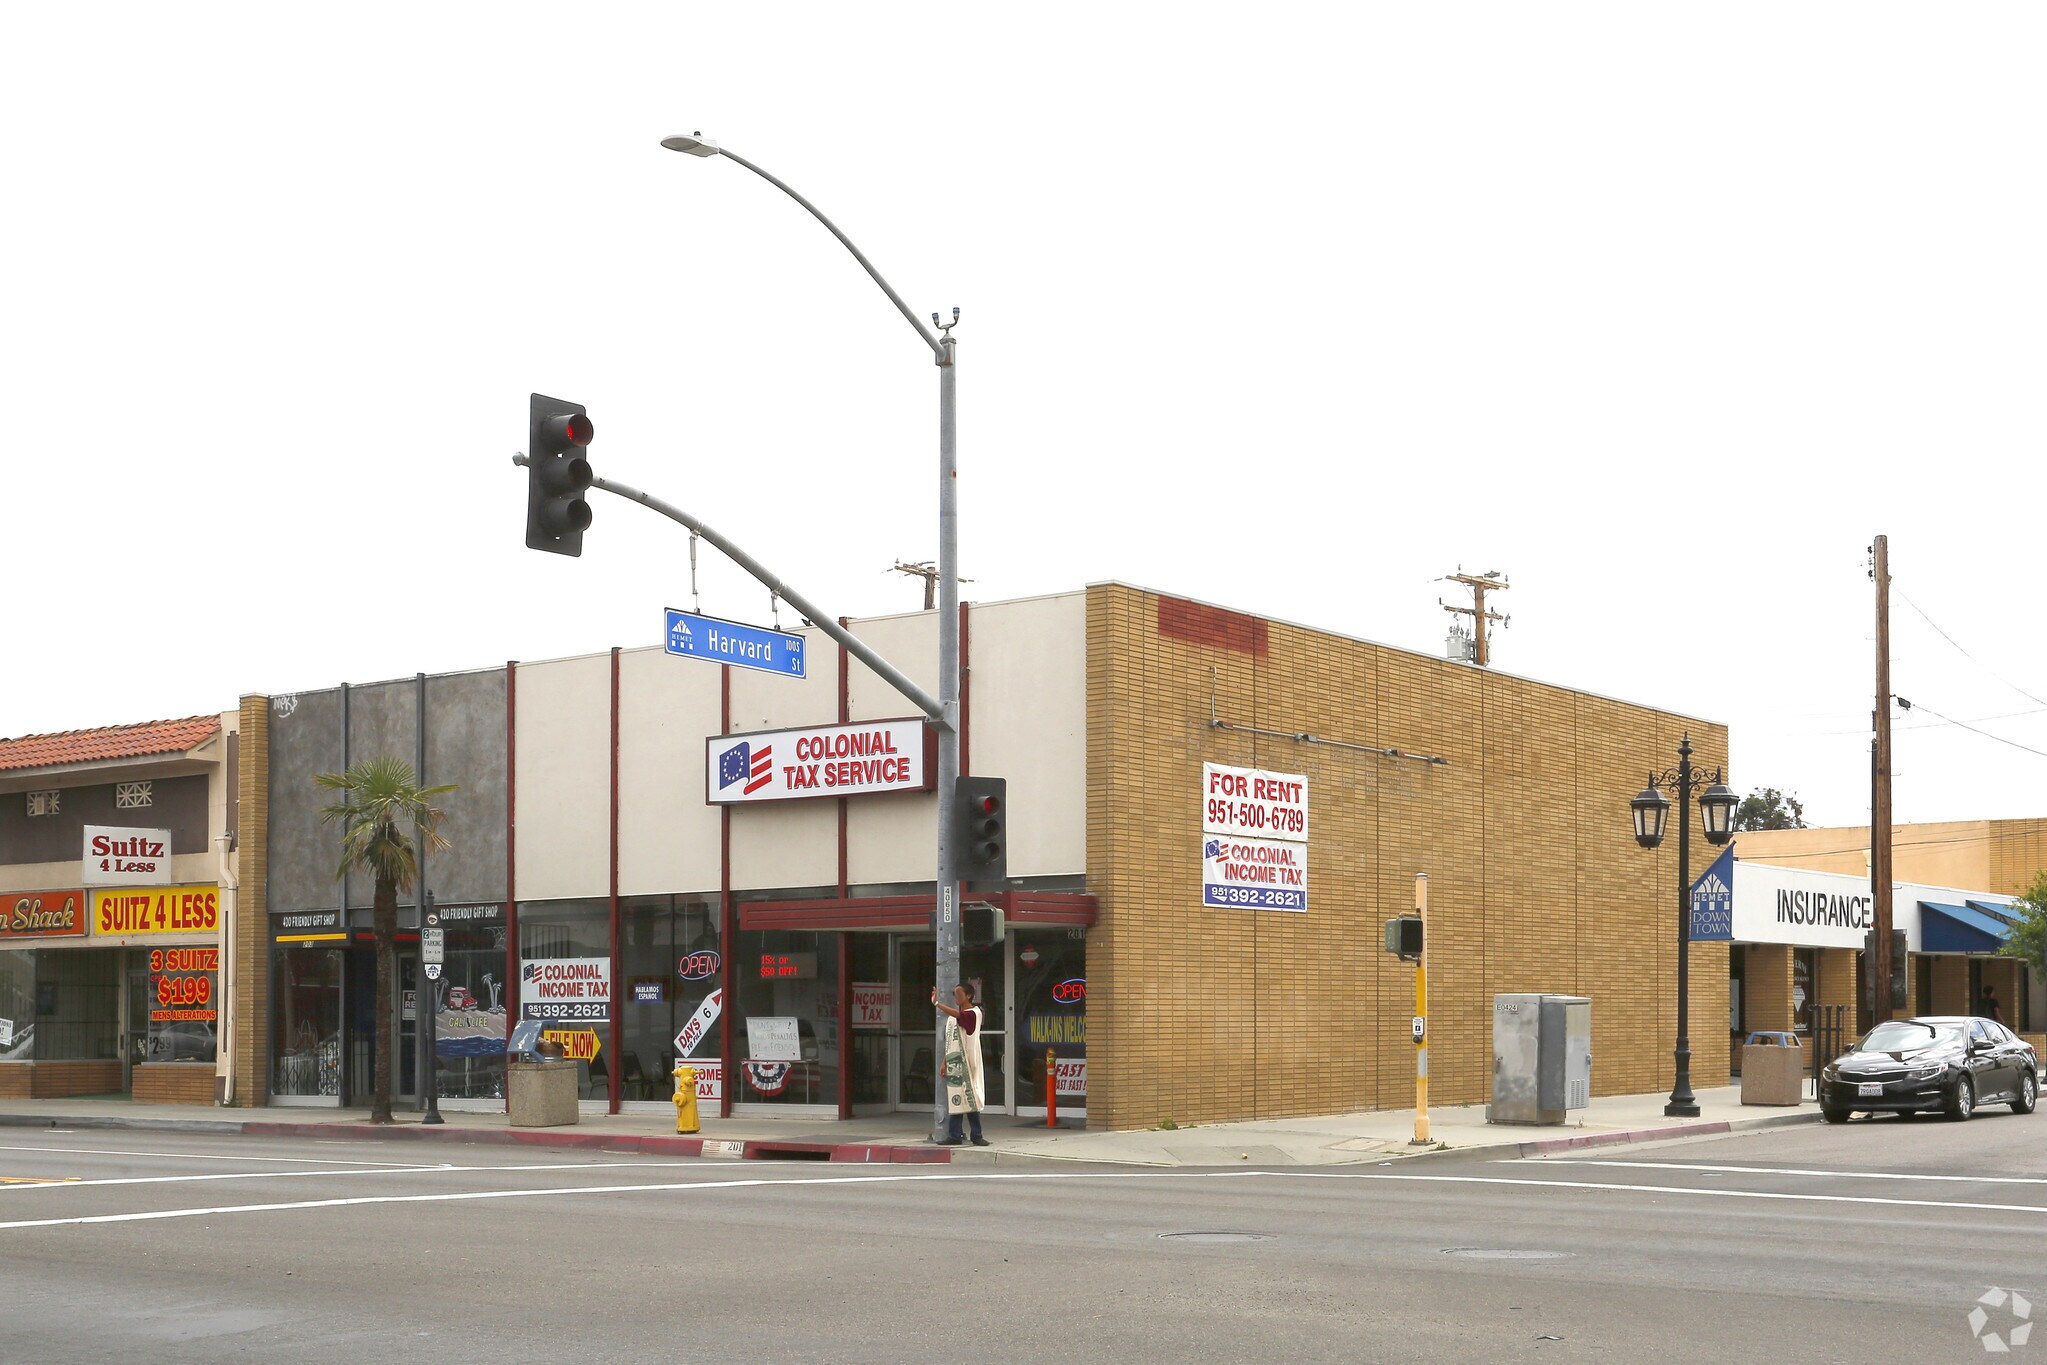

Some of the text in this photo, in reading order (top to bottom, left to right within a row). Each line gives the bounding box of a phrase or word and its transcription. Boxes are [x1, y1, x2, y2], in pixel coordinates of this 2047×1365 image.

[708, 628, 772, 661] Harvard
[791, 657, 801, 671] St
[796, 730, 898, 761] COLONIAL
[783, 757, 910, 790] TAX SERVICE
[1210, 772, 1302, 803] FOR RENT
[1208, 798, 1304, 832] 951-500-6789
[92, 835, 164, 858] Suitz
[1231, 844, 1296, 866] COLONIAL
[100, 859, 156, 872] 4 Less
[1225, 863, 1302, 885] INCOME TAX
[1211, 887, 1300, 905] 951 392-2621
[1694, 893, 1729, 901] HEMET
[12, 897, 74, 930] Shack
[101, 893, 216, 931] SUITZ 4 LESS
[450, 907, 472, 919] FRIENDLY
[473, 906, 484, 918] GIFT
[485, 905, 498, 917] SHOP
[1693, 911, 1729, 922] DOWN
[1777, 888, 1870, 929] INSURANCE
[292, 915, 312, 927] FRIENDLY
[313, 915, 323, 926] GIFT
[323, 914, 335, 925] SHOP
[1693, 923, 1729, 934] TOWN
[423, 930, 429, 939] 2
[150, 948, 219, 972] 3 SUITZ
[679, 955, 717, 975] OPEN
[544, 964, 602, 980] COLONIAL
[158, 975, 211, 1007] $199
[538, 982, 608, 997] INCOME TAX
[1052, 983, 1086, 998] OPEN
[152, 1010, 216, 1020] MENS ALTERATIONS
[542, 1004, 606, 1016] 392-2621
[861, 1005, 882, 1020] TAX
[471, 1017, 488, 1027] LIFE
[678, 1007, 711, 1049] DAYS 6
[1030, 1016, 1063, 1043] WALK-INS
[572, 1033, 594, 1057] NOW
[1056, 1063, 1086, 1077] FAST
[694, 1081, 713, 1096] AX
